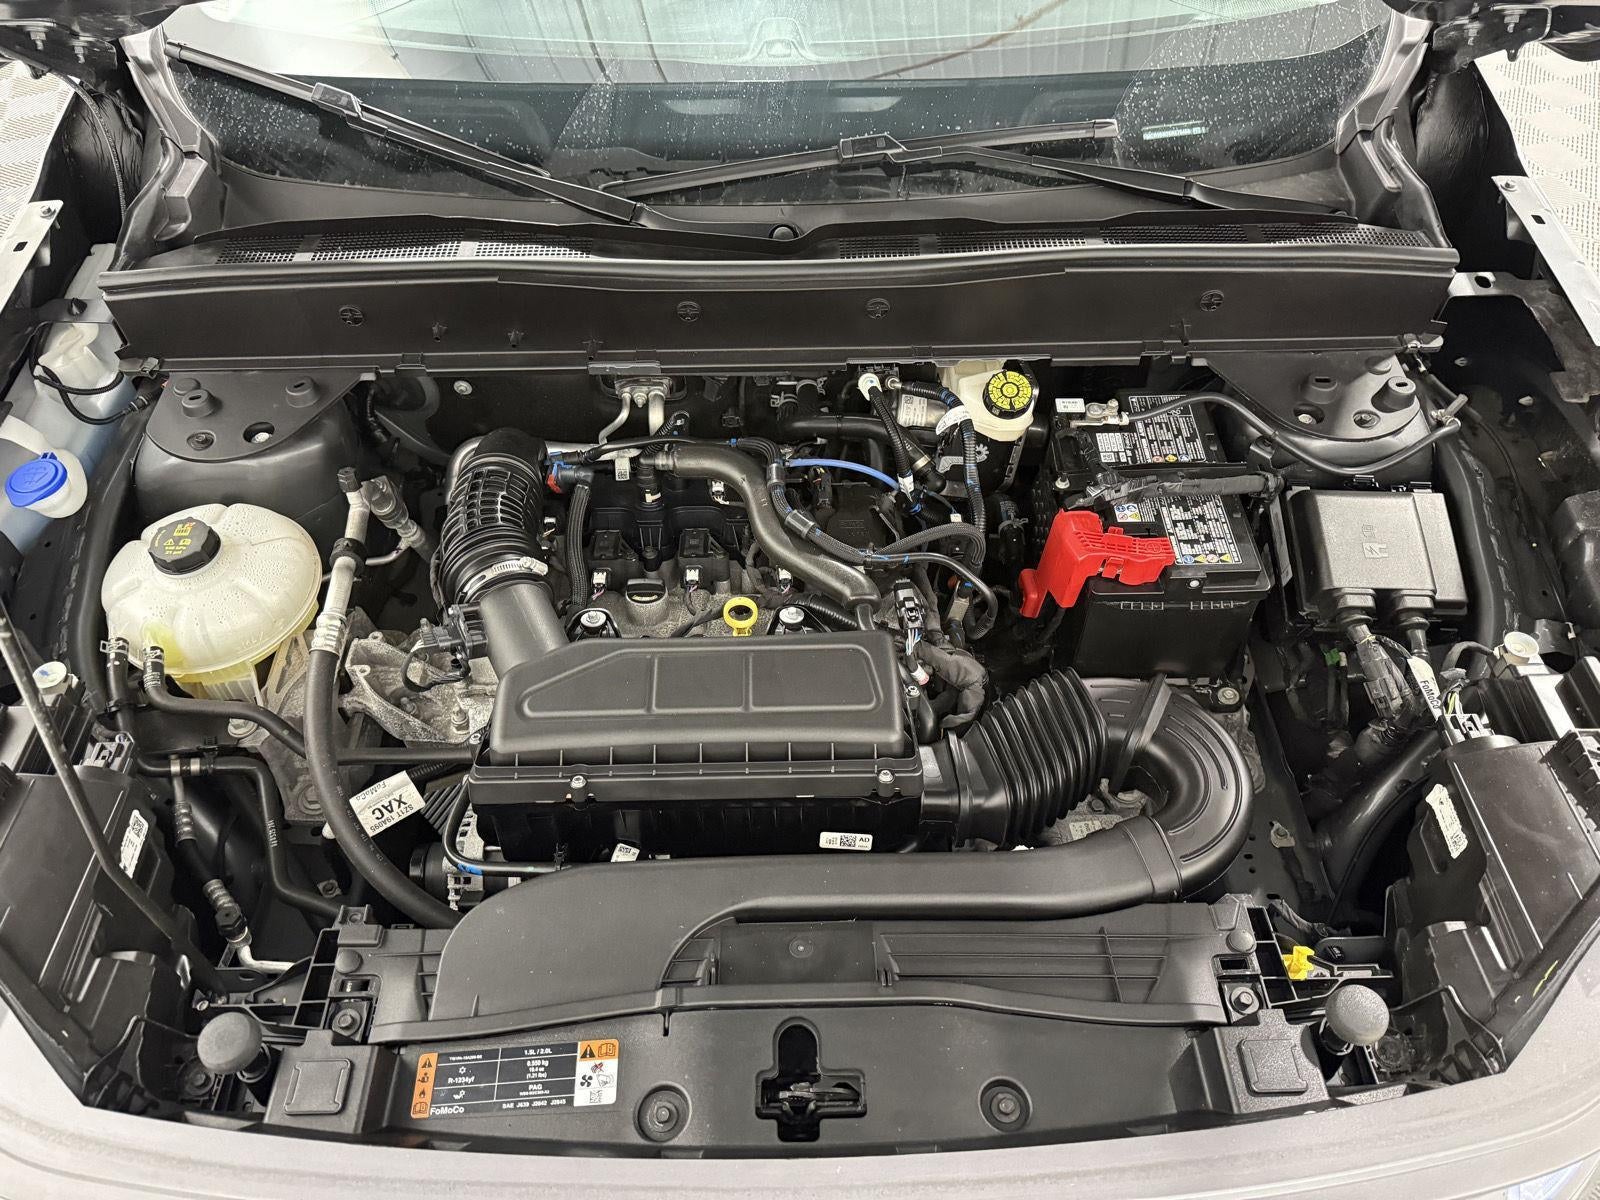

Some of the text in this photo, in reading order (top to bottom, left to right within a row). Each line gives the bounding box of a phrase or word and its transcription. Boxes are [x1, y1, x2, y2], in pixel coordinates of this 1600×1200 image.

[1419, 679, 1440, 710] FoMoCo
[355, 781, 387, 801] FoMoCo
[372, 794, 408, 820] XAC
[396, 804, 414, 817] SZ1T
[369, 815, 395, 833] 19A095
[541, 1059, 549, 1067] kg
[447, 1076, 475, 1085] R-1234yf
[429, 1106, 465, 1116] FoMoCo
